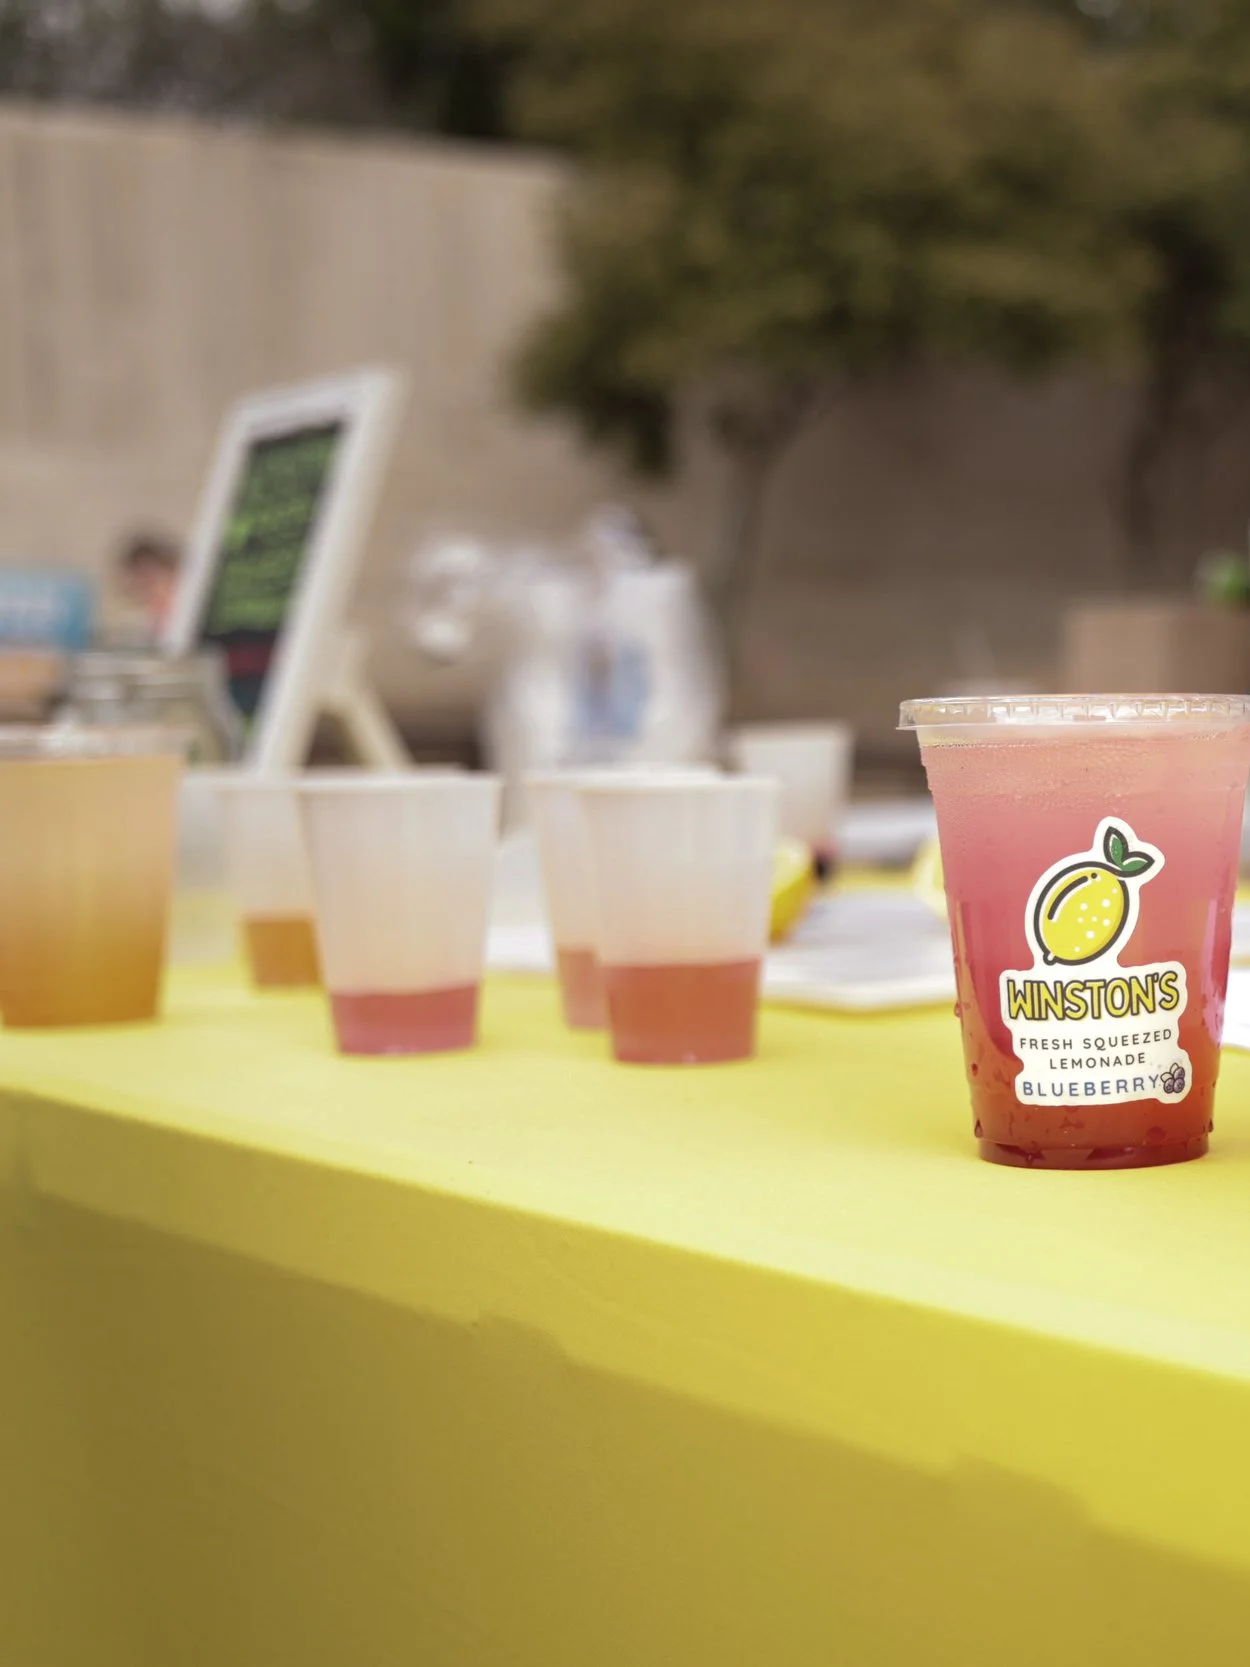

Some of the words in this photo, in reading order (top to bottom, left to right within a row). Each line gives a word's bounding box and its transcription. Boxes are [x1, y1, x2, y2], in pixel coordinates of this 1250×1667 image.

[1007, 971, 1180, 1021] WINSTON'S
[1020, 1038, 1073, 1050] FRESH
[1083, 1029, 1172, 1051] SQUEEZED
[1049, 1052, 1146, 1070] LEMONADE
[1023, 1074, 1159, 1097] BLUEBERRY
